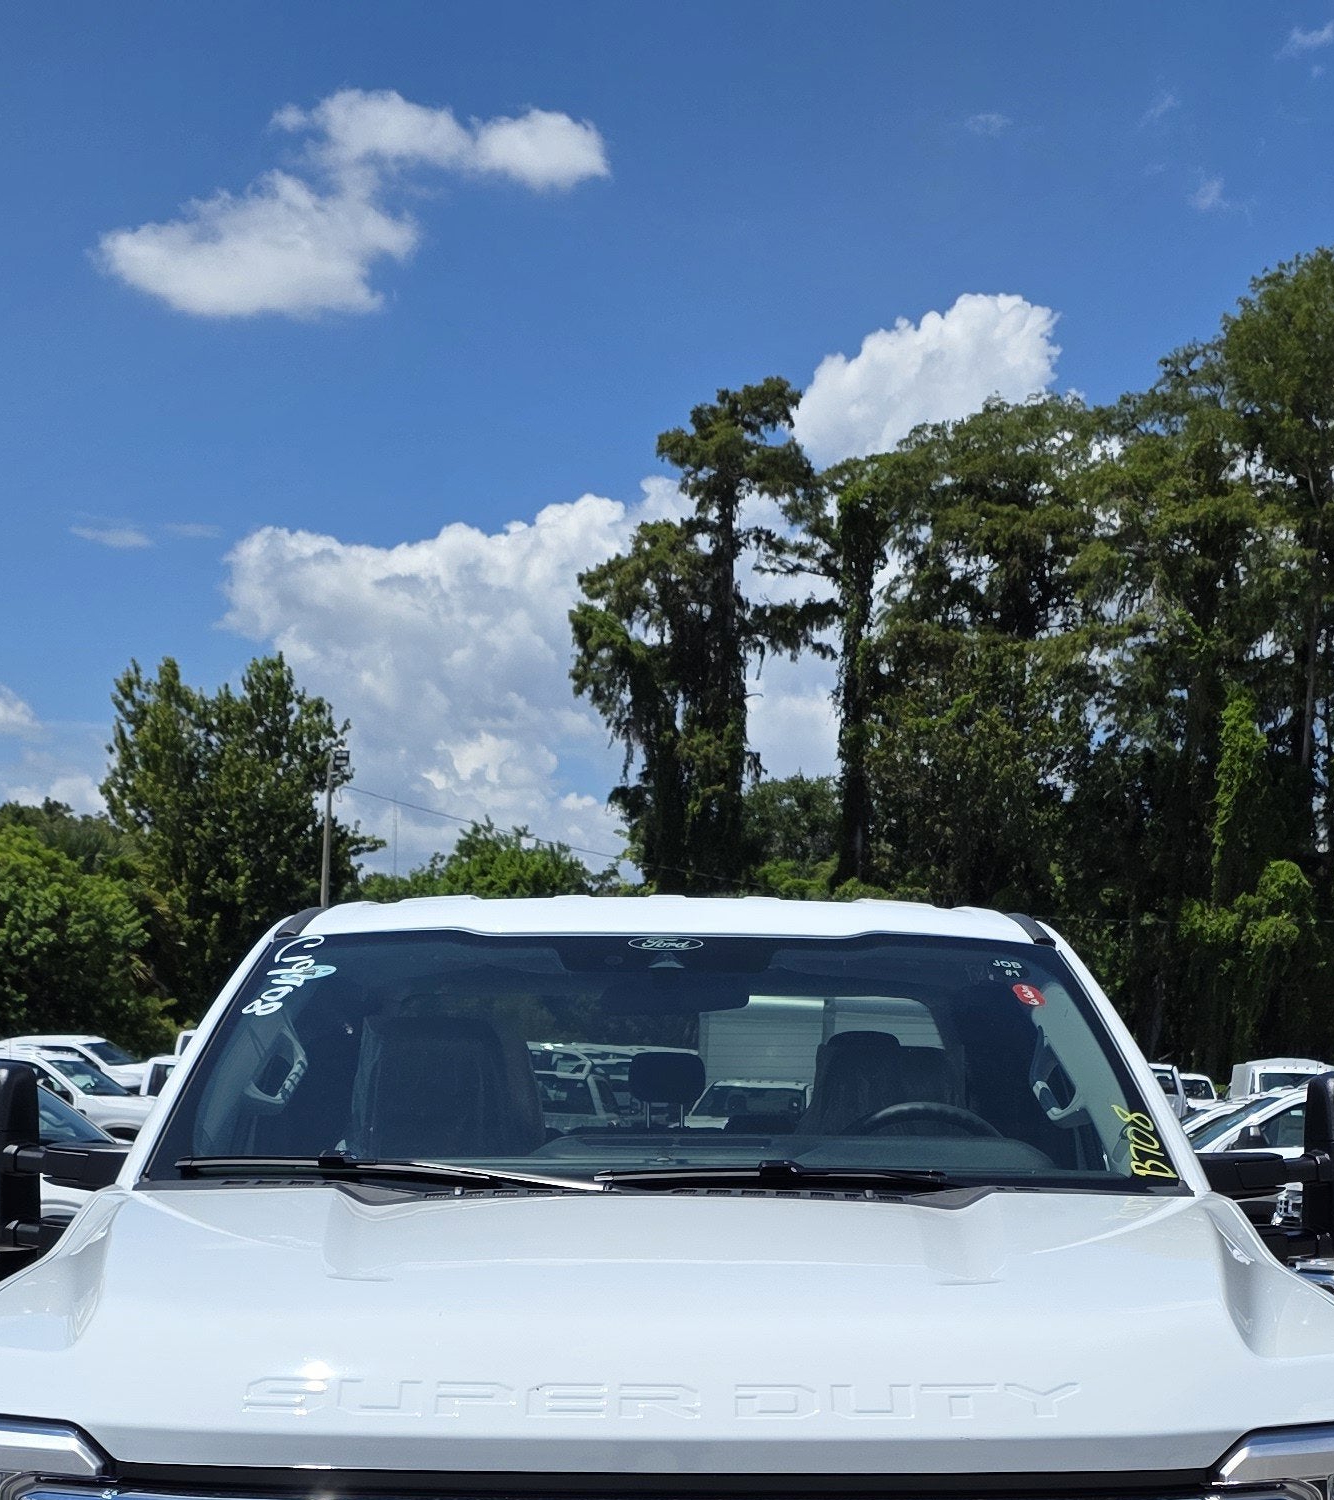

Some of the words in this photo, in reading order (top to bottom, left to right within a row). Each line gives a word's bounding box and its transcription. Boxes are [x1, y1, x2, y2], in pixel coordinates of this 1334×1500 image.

[641, 936, 690, 949] Ford
[992, 959, 1022, 969] JOB
[1111, 1104, 1179, 1178] B708
[242, 1375, 702, 1420] SUPER
[733, 1382, 1081, 1419] DUTY
